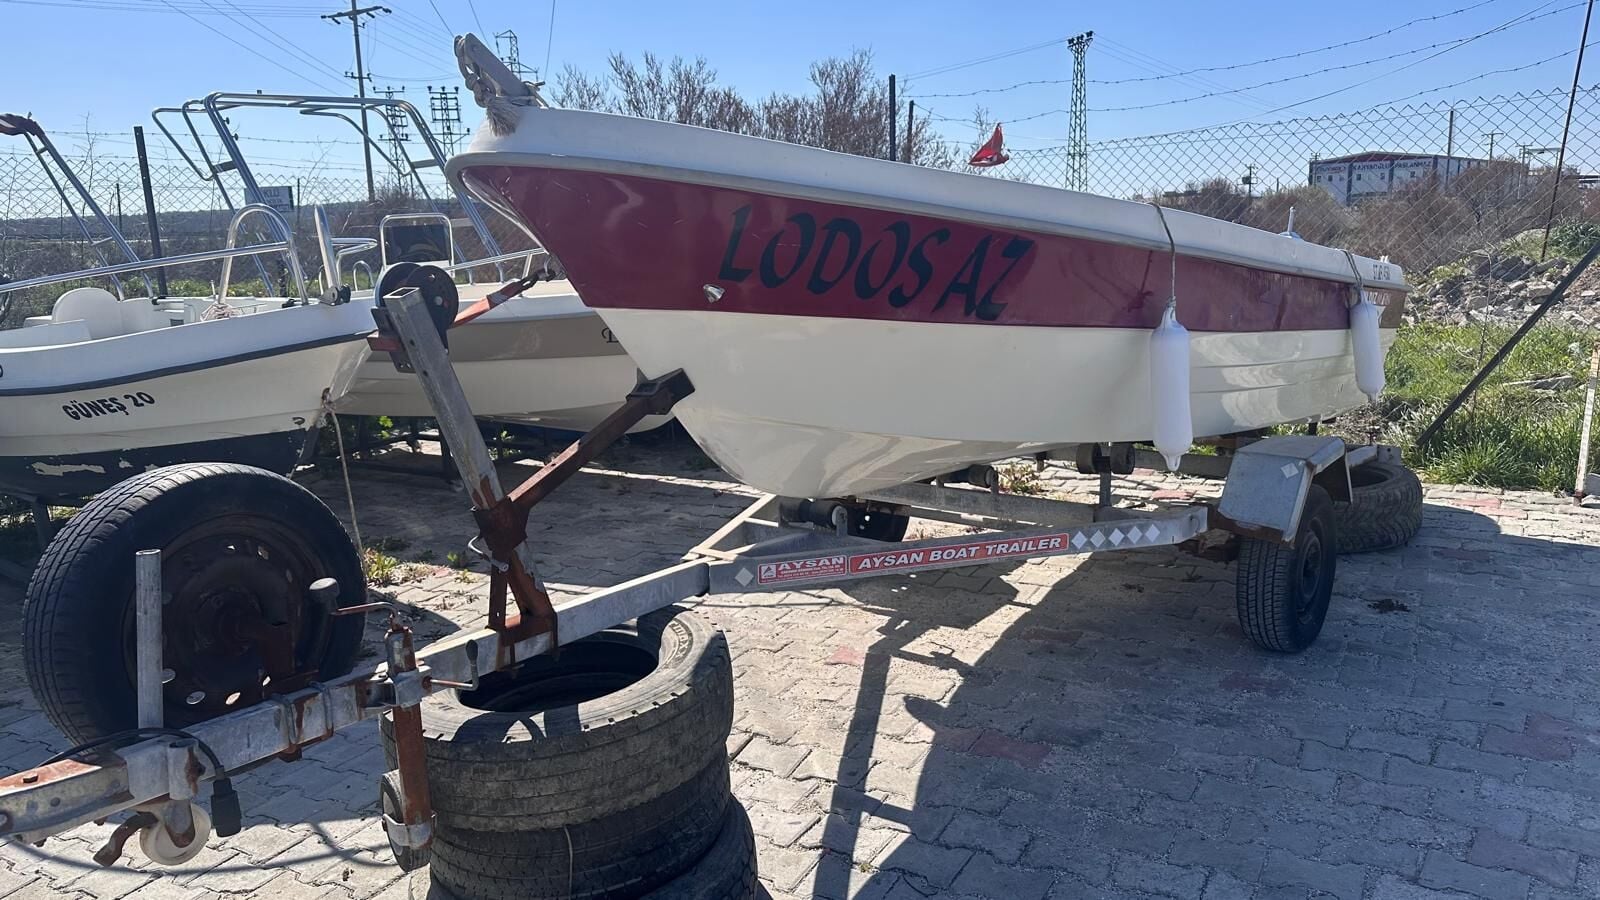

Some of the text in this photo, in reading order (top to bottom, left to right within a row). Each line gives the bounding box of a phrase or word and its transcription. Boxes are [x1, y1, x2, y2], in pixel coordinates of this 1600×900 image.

[717, 204, 1036, 321] LODOS AZ
[62, 391, 155, 421] GÜNEŞ 20
[778, 556, 844, 571] AYSAN
[857, 537, 1062, 570] AYSAN BOAT TRAILER
